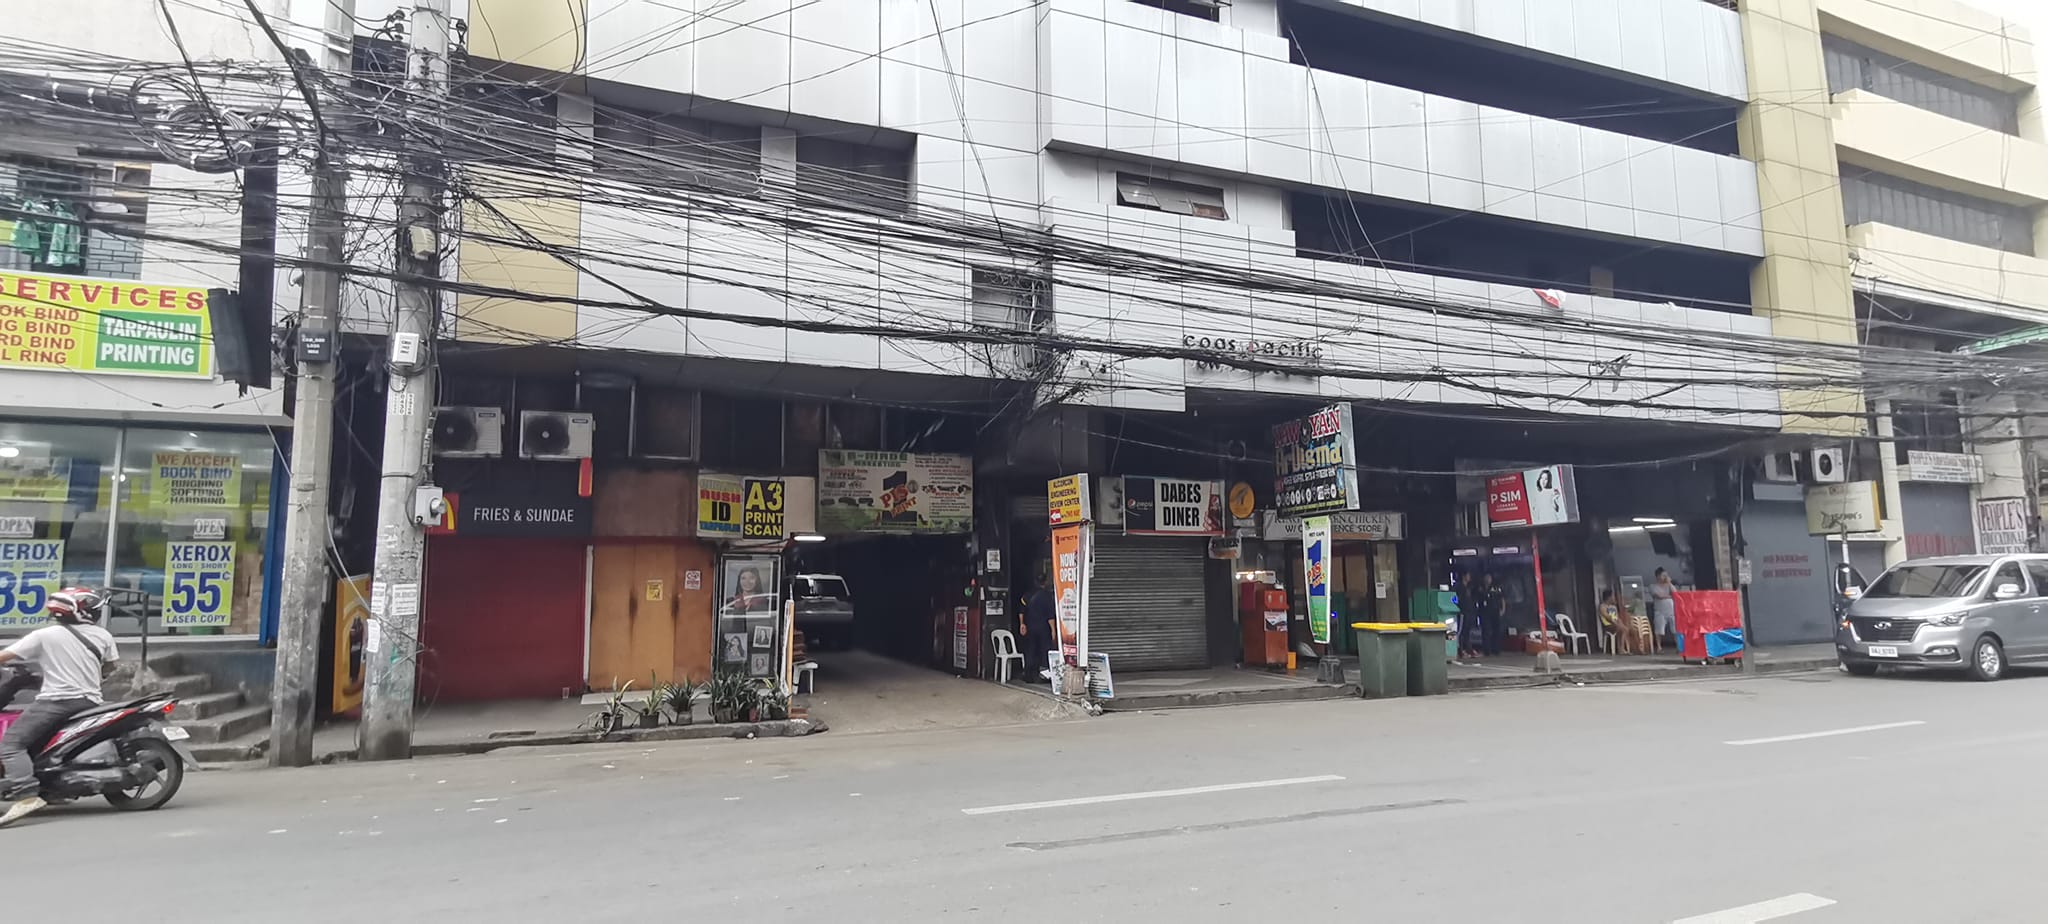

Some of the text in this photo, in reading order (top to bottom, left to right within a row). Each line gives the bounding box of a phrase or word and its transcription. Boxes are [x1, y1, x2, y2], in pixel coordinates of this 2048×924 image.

[0, 277, 205, 310] ERVICES
[35, 307, 80, 322] BIND
[26, 321, 71, 335] BIND
[104, 318, 196, 341] TARPAULIN
[30, 337, 76, 350] BIND
[20, 351, 67, 364] RING
[100, 342, 195, 366] PRINTING
[1308, 408, 1341, 438] YAN
[156, 454, 239, 467] WE ACCEPT
[160, 467, 198, 479] BOOK
[700, 489, 741, 503] RUSH
[745, 481, 783, 511] A3
[1161, 482, 1202, 504] DABES
[1500, 490, 1522, 503] SIM
[473, 507, 575, 523] FRIES & SUNDAE
[711, 501, 731, 522] ID
[745, 511, 784, 524] PRINT
[1163, 506, 1200, 527] DINER
[195, 519, 225, 534] OPEN
[1347, 514, 1391, 525] CHICKEN
[744, 524, 783, 537] SCAN
[1357, 524, 1382, 533] STORE
[0, 543, 60, 560] EROX
[171, 545, 232, 562] XEROX
[1059, 552, 1077, 568] NOW
[1060, 567, 1077, 582] OPEN
[166, 614, 227, 625] LASER COPY
